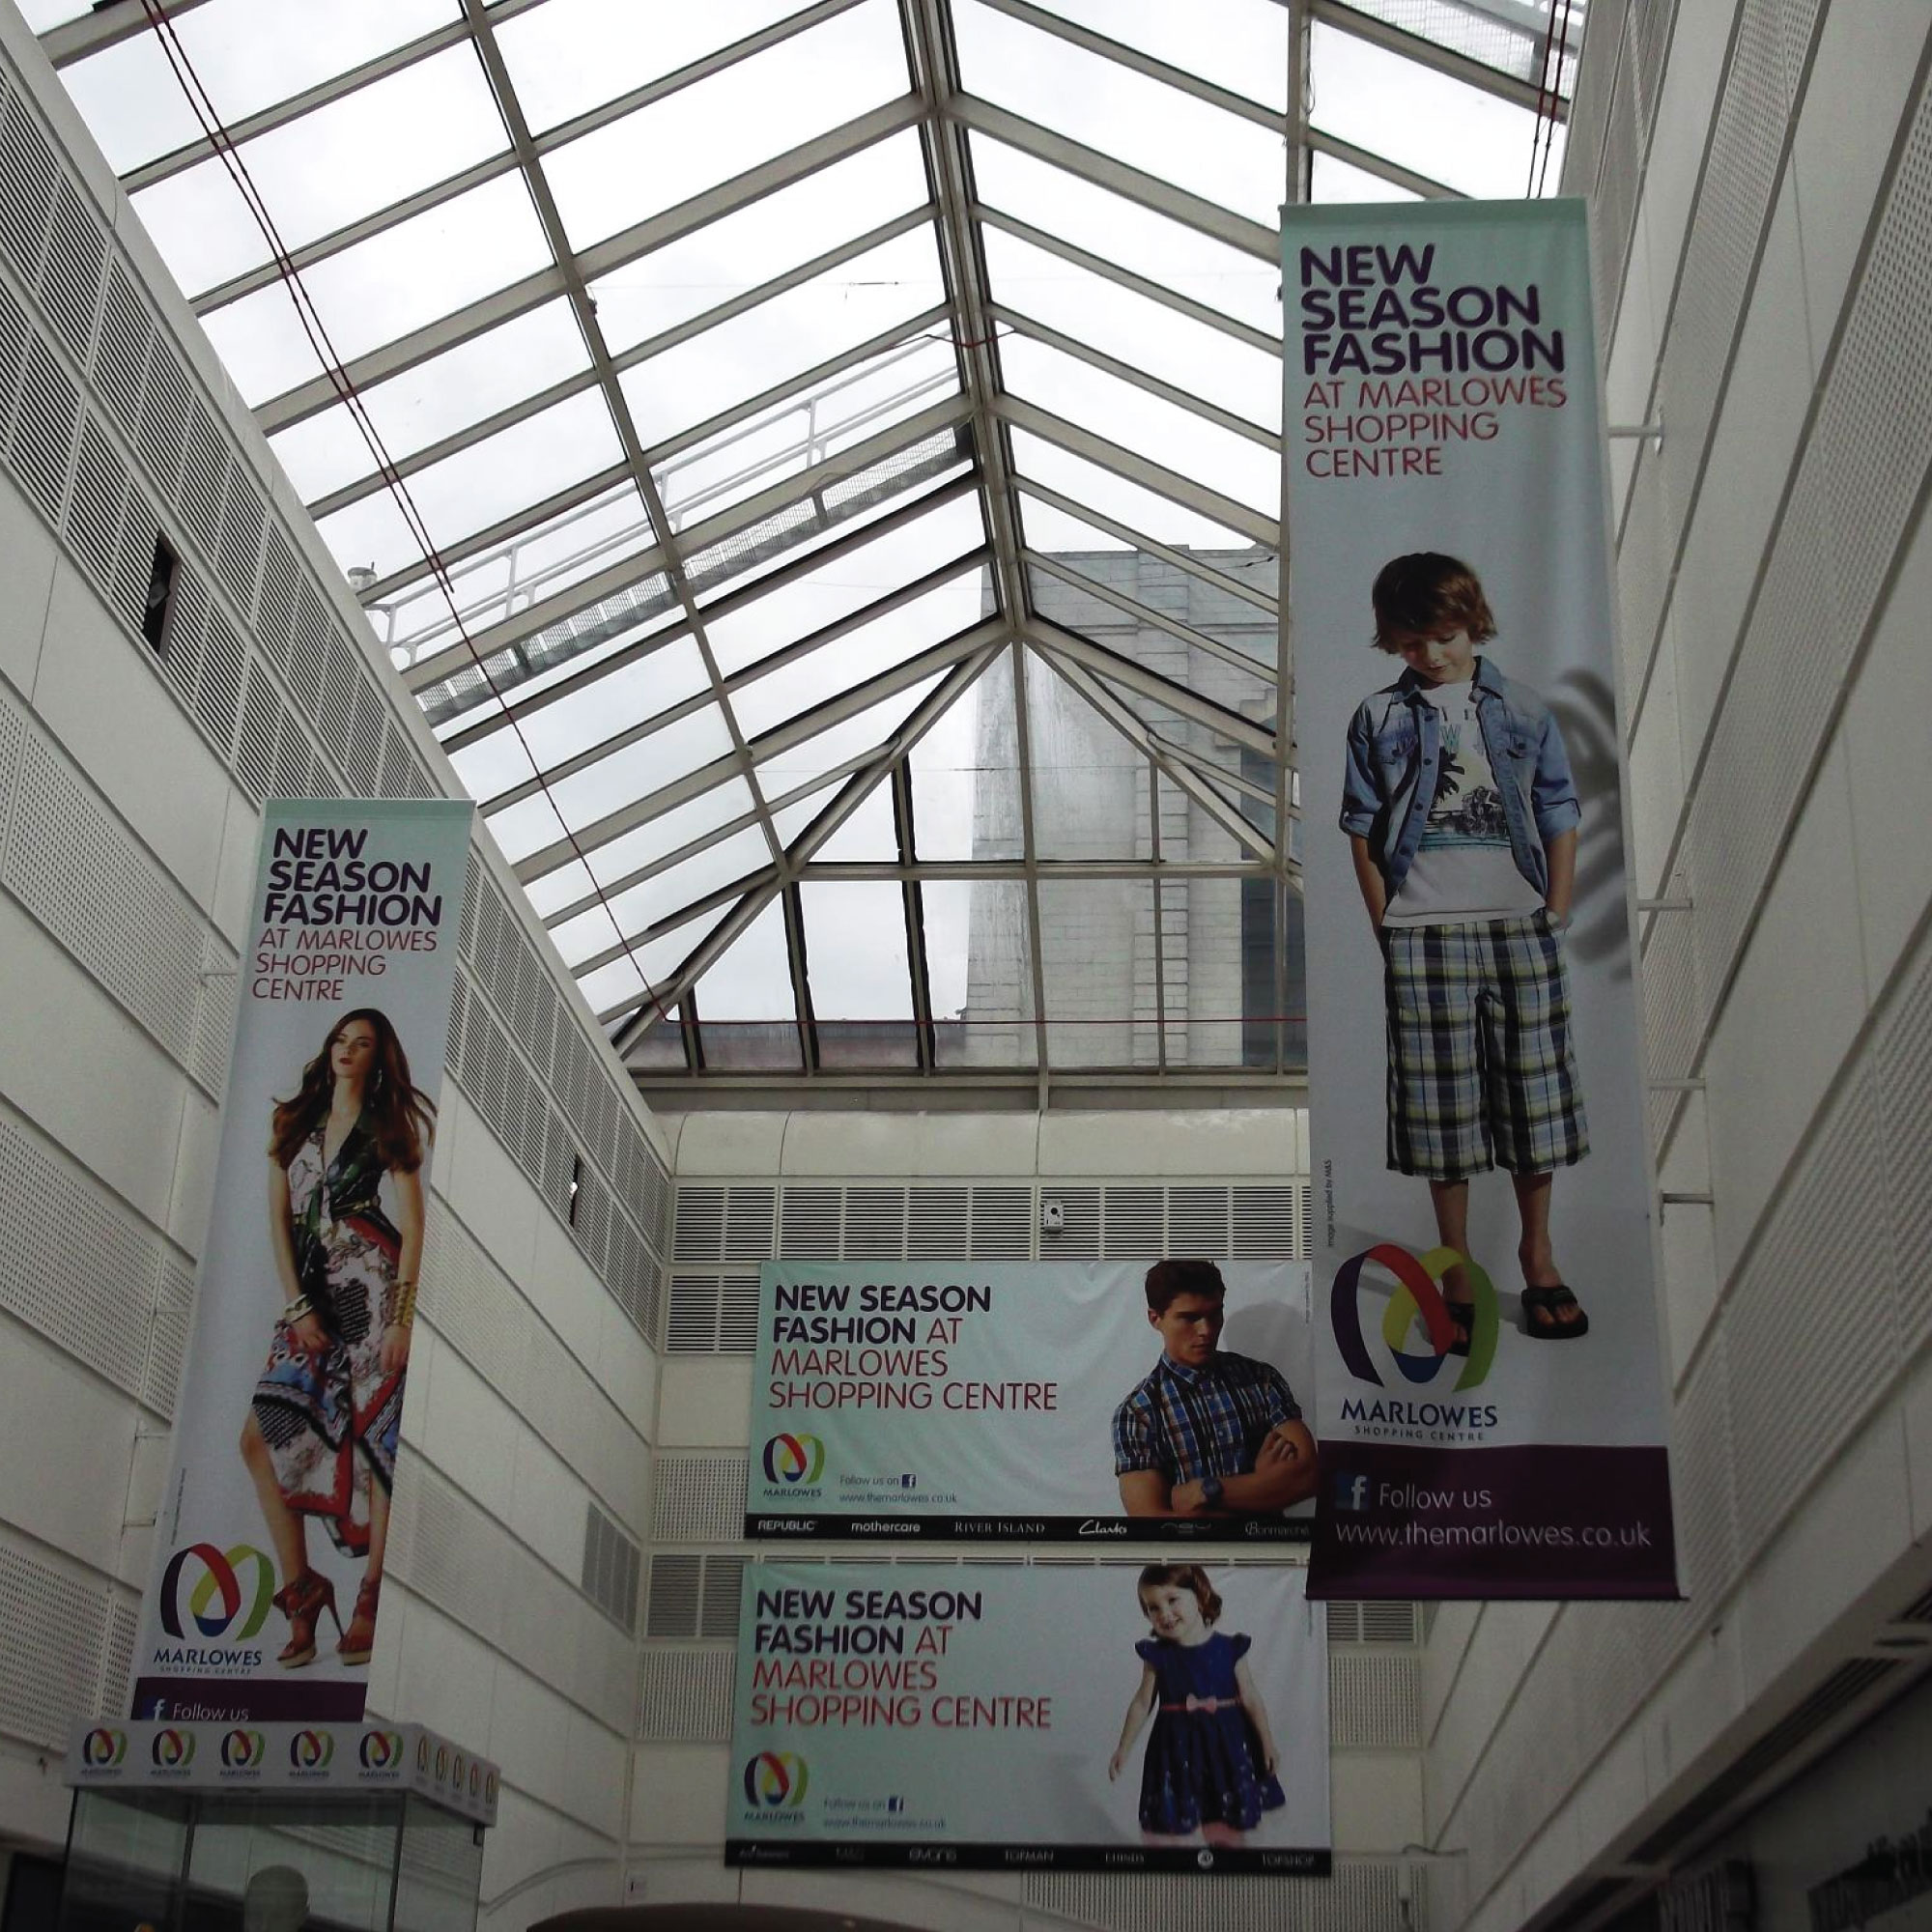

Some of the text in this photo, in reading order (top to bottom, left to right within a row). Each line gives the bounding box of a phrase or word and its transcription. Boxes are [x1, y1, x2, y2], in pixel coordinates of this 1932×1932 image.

[1300, 243, 1435, 287] NEW
[1301, 284, 1540, 330] SEASON
[1303, 328, 1564, 375] FASHION
[1304, 376, 1568, 409] AT MARLOWES
[1305, 412, 1499, 443] SHOPPING
[1306, 447, 1442, 477] CENTRE
[273, 828, 368, 860] NEW
[268, 861, 431, 893] SEASON
[264, 893, 442, 925] FASHION
[258, 928, 438, 952] AT MARLOWES
[255, 952, 386, 976] SHOPPING
[252, 979, 344, 1001] CENTRE
[774, 1285, 991, 1313] NEW SEASON
[772, 1317, 963, 1345] FASHION AT
[771, 1349, 948, 1377] MARLOWES
[769, 1381, 1057, 1410] SHOPPING CENTRE
[1341, 1398, 1498, 1429] MARLOWES
[1354, 1425, 1485, 1441] SHOPPING CENTRE
[763, 1488, 822, 1498] MARLOWES
[839, 1474, 870, 1487] Follow
[872, 1477, 885, 1486] us
[1378, 1483, 1453, 1509] Follow
[1463, 1489, 1492, 1509] us
[757, 1520, 815, 1531] REPUBLIC
[851, 1520, 921, 1532] mothercare
[954, 1521, 1045, 1534] RIVER ISLAND
[1078, 1519, 1128, 1536] Clarks
[1336, 1520, 1652, 1547] www.themarlowes.co.uk
[755, 1589, 982, 1621] NEW SEASON
[753, 1624, 952, 1655] FASHION AT
[154, 1648, 262, 1665] MARLOWES
[753, 1660, 938, 1691] MARLOWES
[172, 1701, 225, 1720] Follow
[230, 1707, 249, 1720] us
[750, 1695, 1052, 1728] SHOPPING CENTRE
